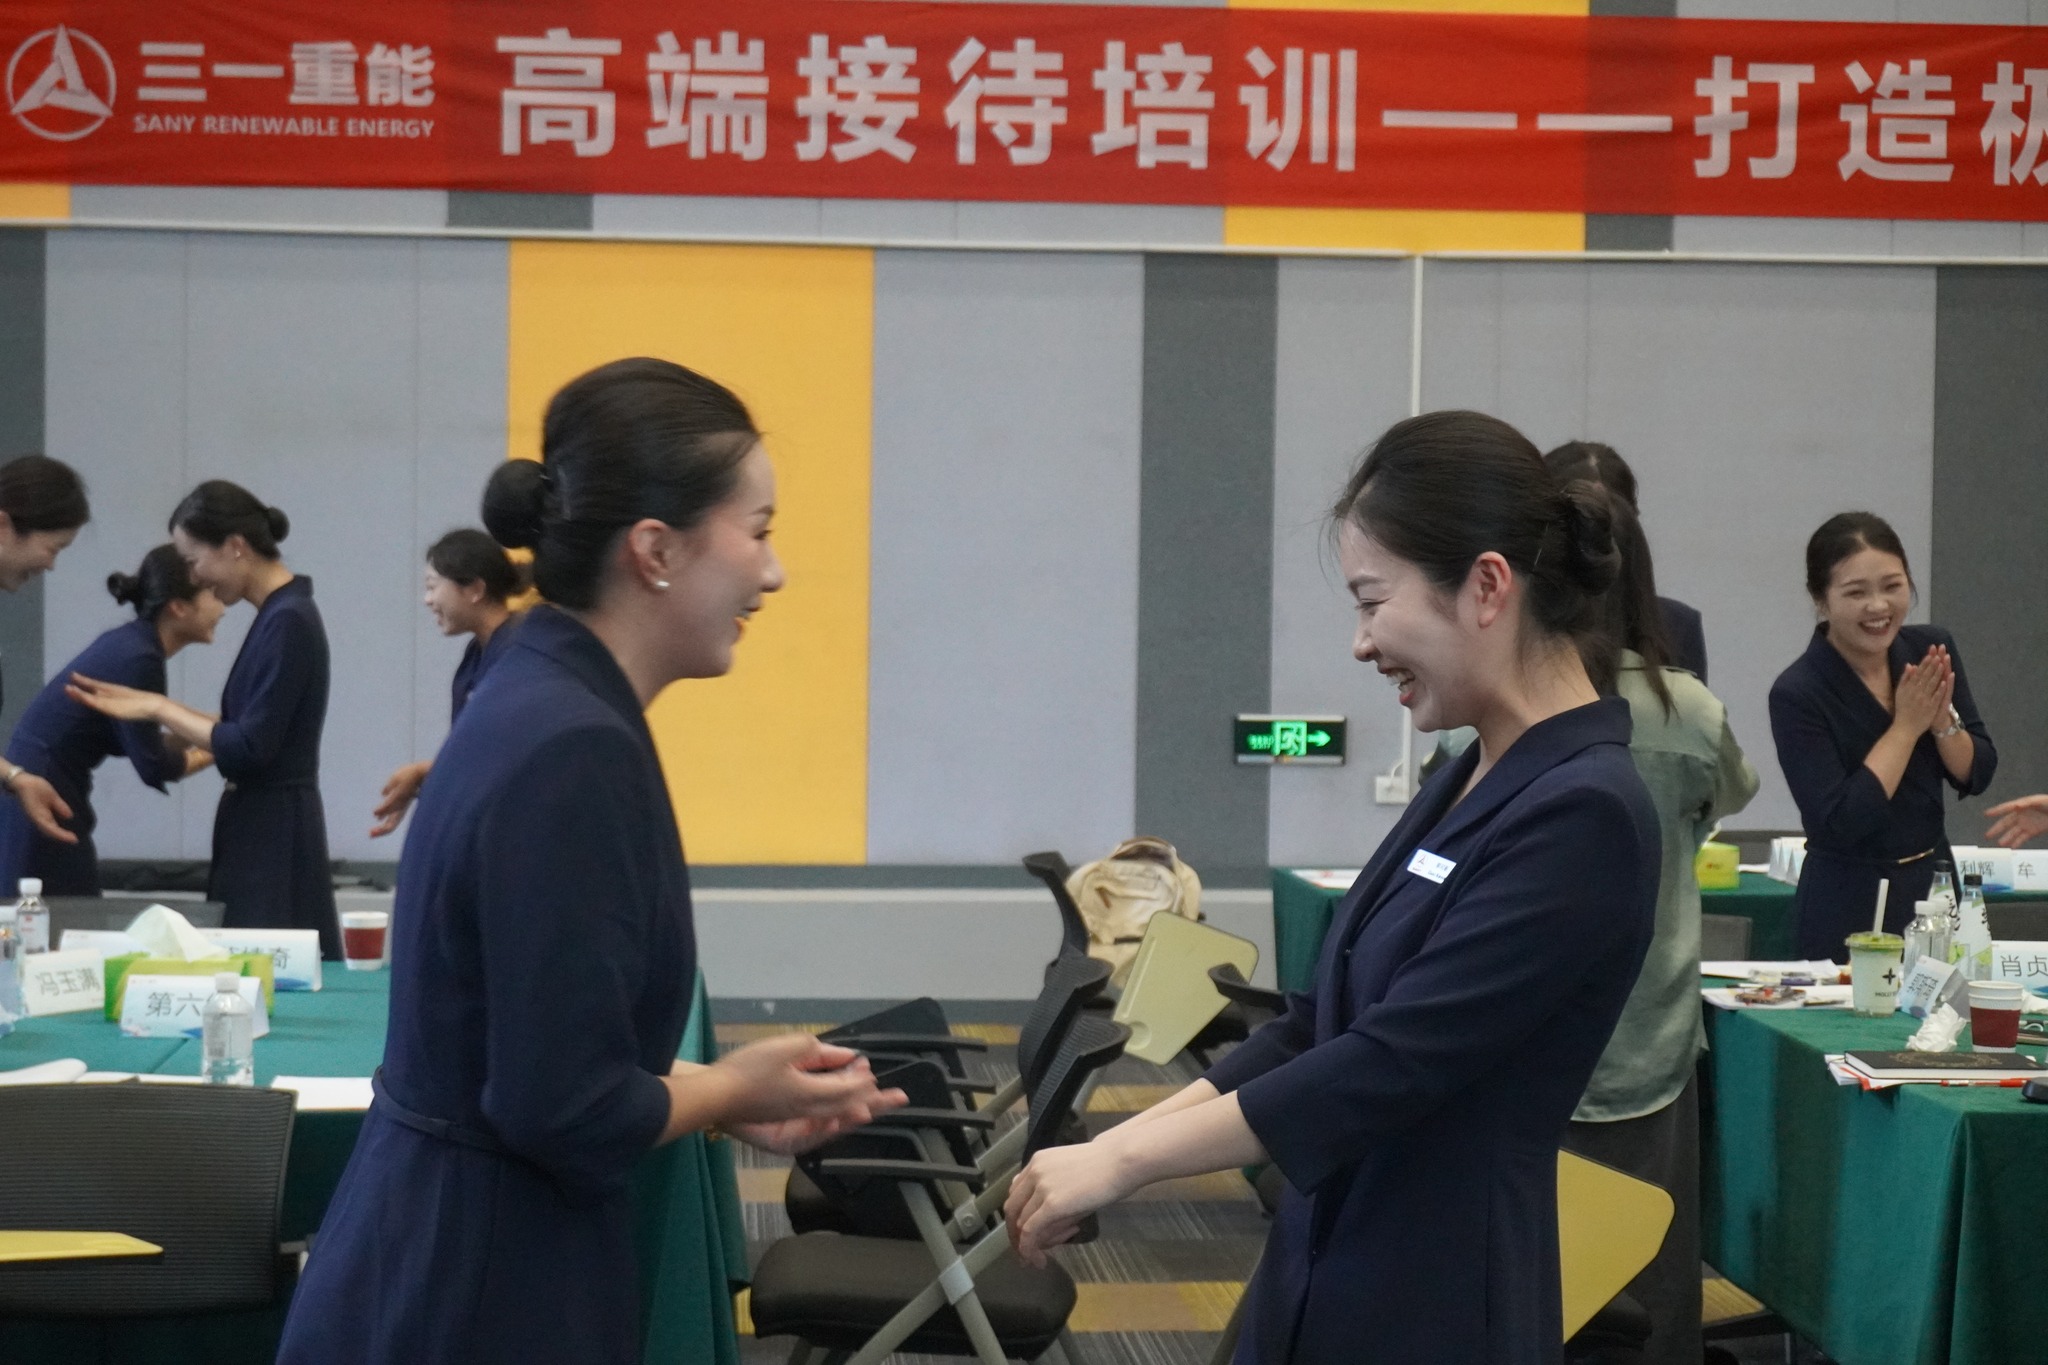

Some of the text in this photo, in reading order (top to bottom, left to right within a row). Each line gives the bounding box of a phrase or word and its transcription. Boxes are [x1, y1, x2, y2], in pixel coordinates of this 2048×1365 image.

[137, 40, 435, 107] 三一重能
[133, 113, 435, 139] SANY RENEWABLE ENERGY
[145, 991, 214, 1018] 第六
